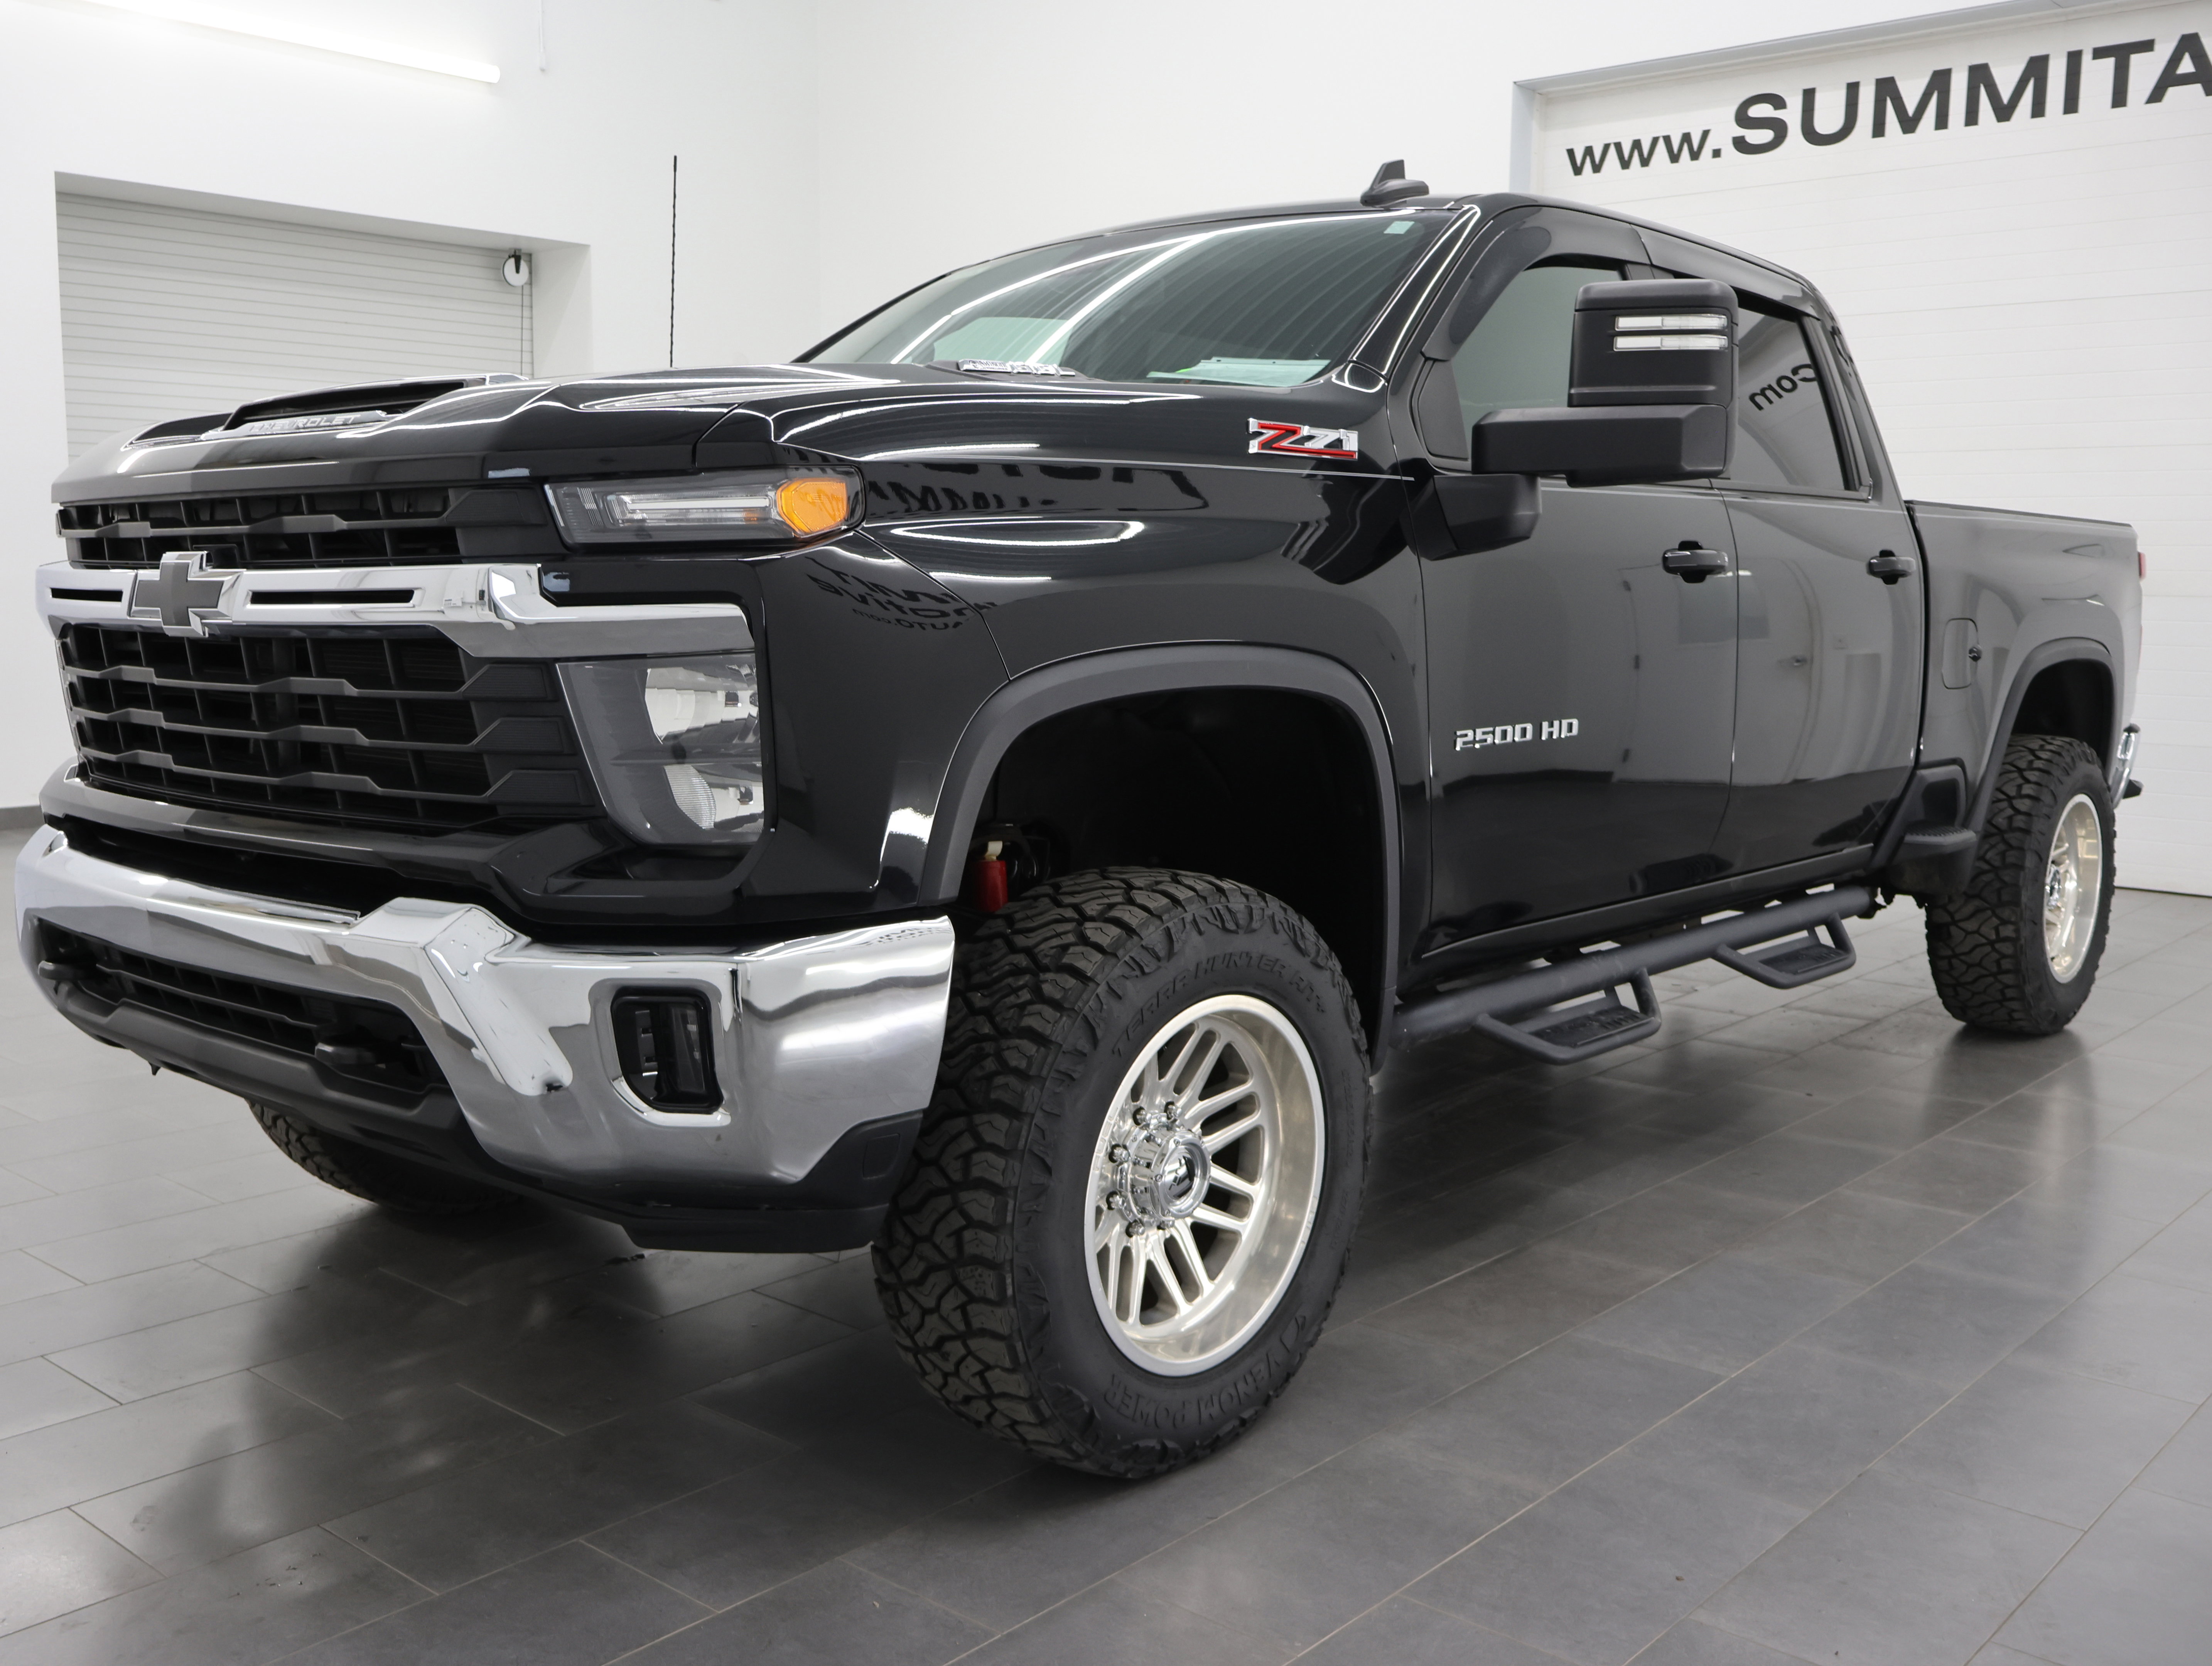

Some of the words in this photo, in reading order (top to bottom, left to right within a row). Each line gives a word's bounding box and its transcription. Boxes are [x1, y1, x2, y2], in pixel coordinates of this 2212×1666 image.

[1566, 32, 2212, 176] www.SUMMITA
[249, 414, 362, 433] CHEVROLET
[1248, 418, 1358, 460] Z71
[1455, 723, 1533, 750] 2500
[1541, 718, 1578, 740] HD
[1194, 951, 1287, 980] HUNTER
[1103, 1374, 1186, 1429] POWER
[1198, 1351, 1281, 1425] VENOM
